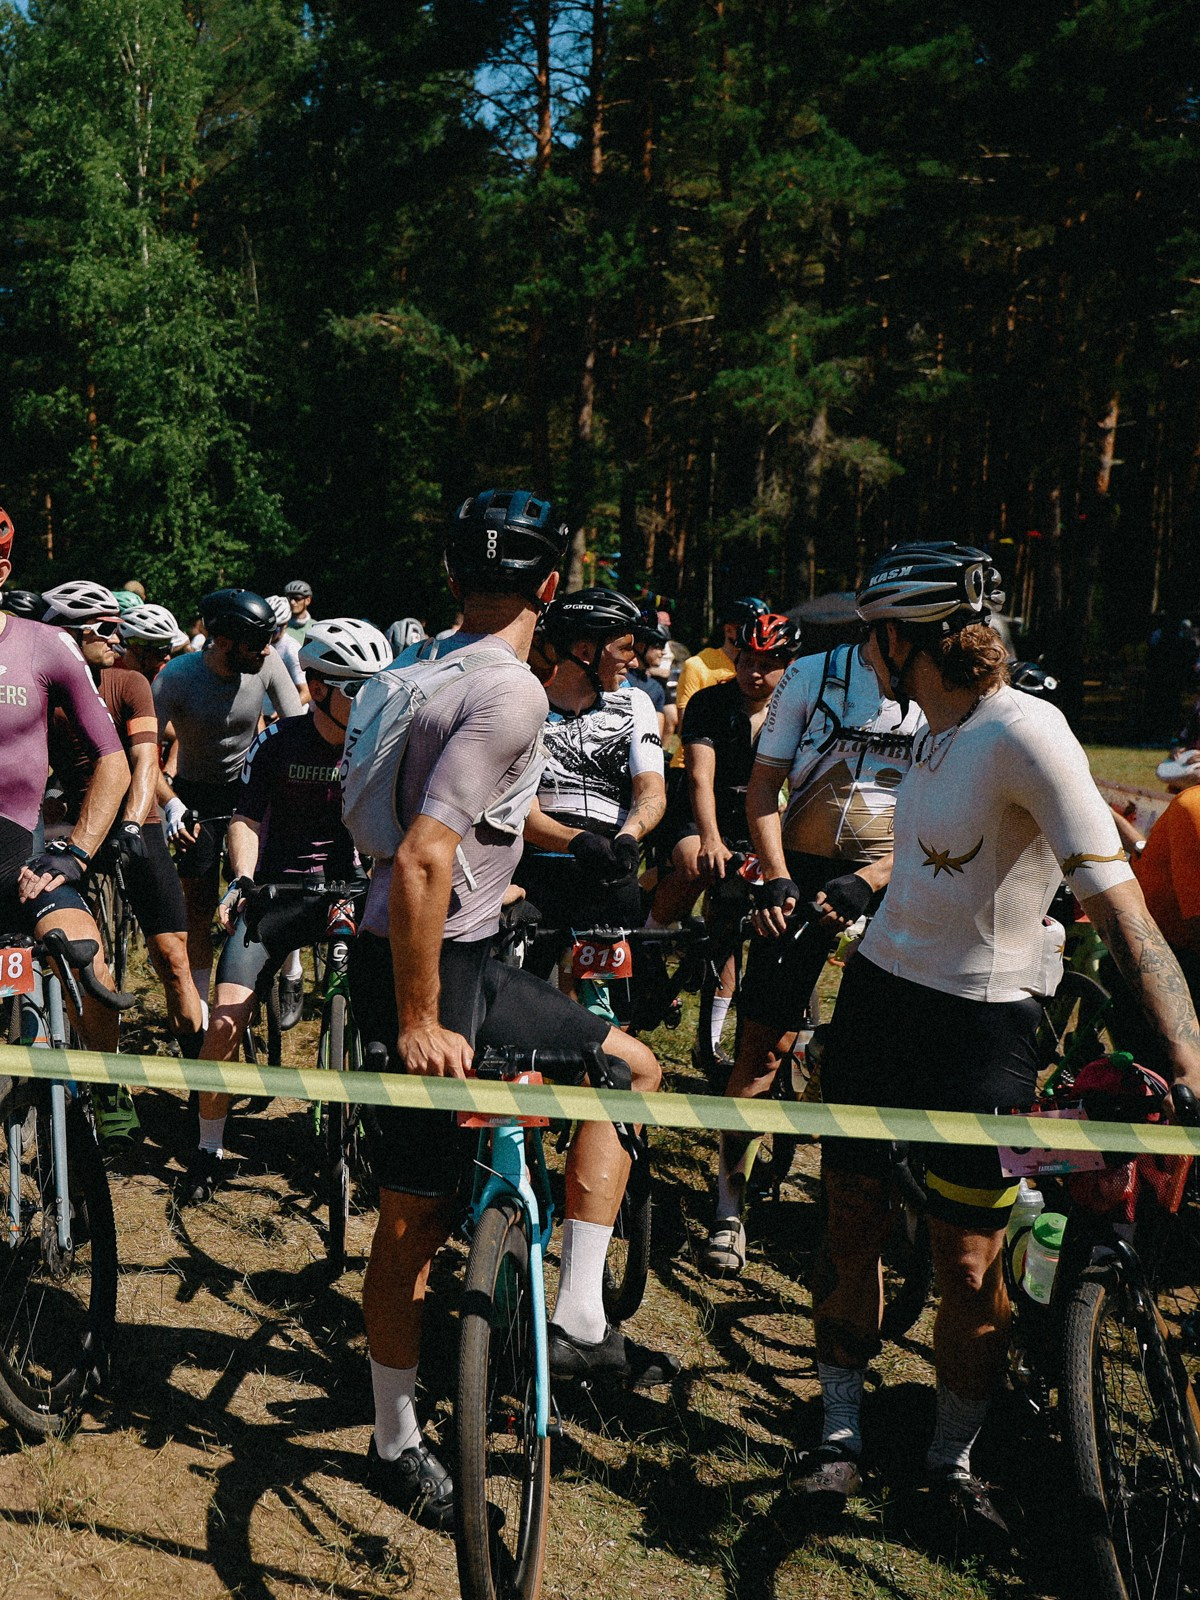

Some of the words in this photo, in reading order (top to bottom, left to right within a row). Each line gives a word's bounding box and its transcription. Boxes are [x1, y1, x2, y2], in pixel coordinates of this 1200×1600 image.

[486, 529, 498, 559] POC
[869, 566, 914, 588] KASK
[766, 666, 800, 733] COLOMBIA
[579, 945, 626, 967] 819
